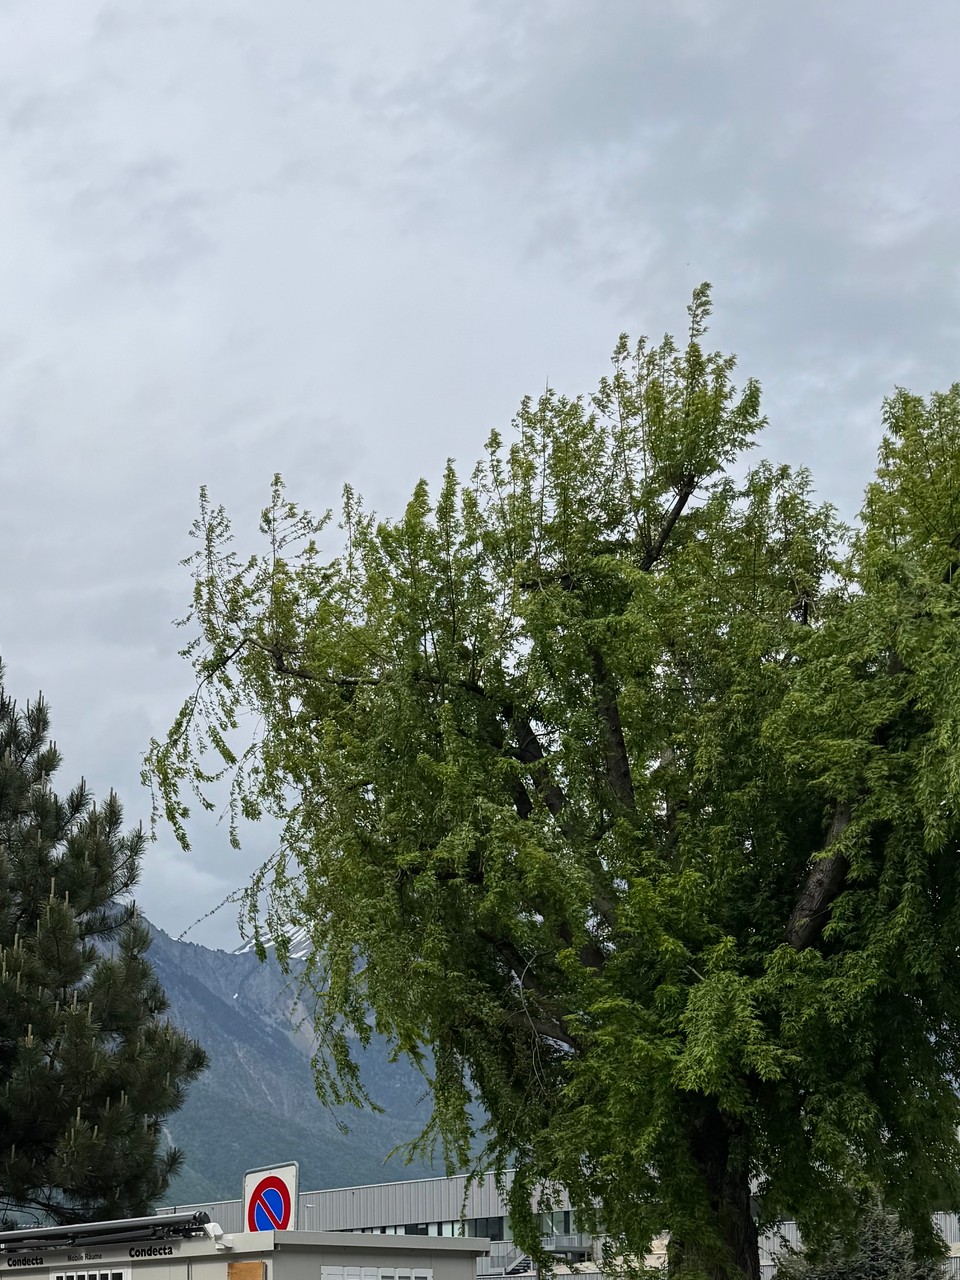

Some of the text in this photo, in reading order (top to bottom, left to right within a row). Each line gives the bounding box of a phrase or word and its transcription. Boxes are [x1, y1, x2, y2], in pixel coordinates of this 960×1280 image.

[128, 1245, 173, 1258] Condecta
[7, 1256, 44, 1267] Condecta
[67, 1254, 84, 1262] Mobile
